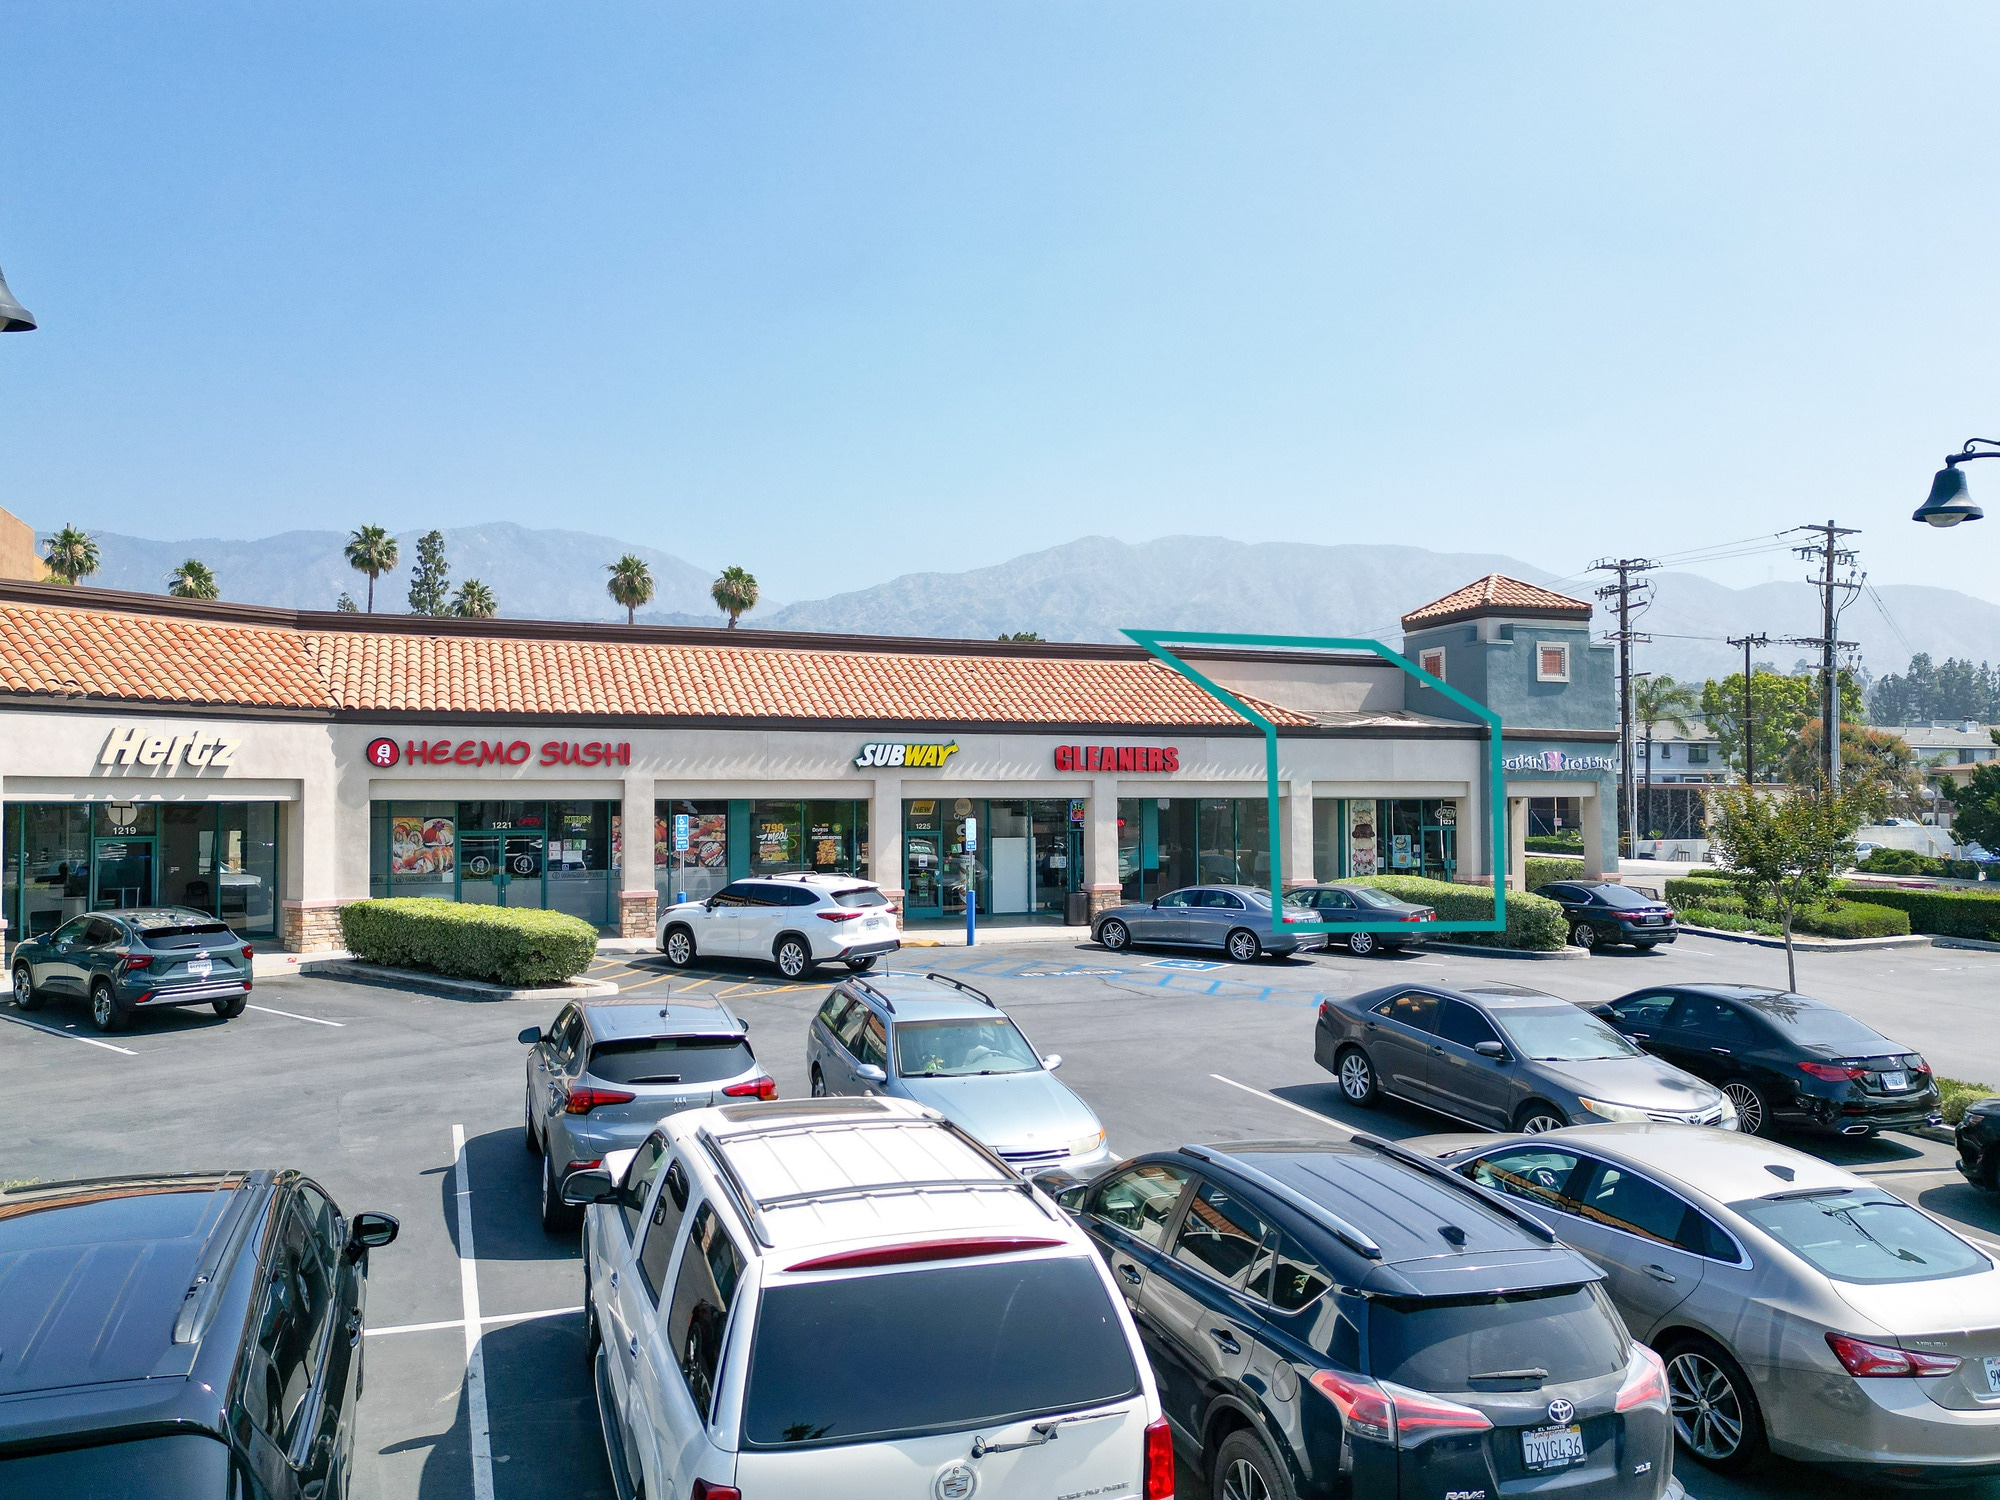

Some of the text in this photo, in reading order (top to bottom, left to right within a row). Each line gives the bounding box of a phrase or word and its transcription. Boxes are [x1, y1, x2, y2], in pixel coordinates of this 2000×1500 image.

[101, 726, 241, 766] Hertz
[405, 740, 631, 767] HEEMO SUSHI
[856, 744, 960, 767] SUBWAY
[1055, 745, 1180, 772] CLEANERS
[1436, 808, 1456, 818] OPEN
[492, 821, 512, 829] 1221
[518, 817, 540, 826] OPEN
[564, 815, 591, 824] KIRIN
[112, 826, 137, 835] 1219
[1526, 1436, 1582, 1465] 7XVG436
[1634, 1461, 1652, 1475] XLE
[1444, 1490, 1485, 1500] RAV4
